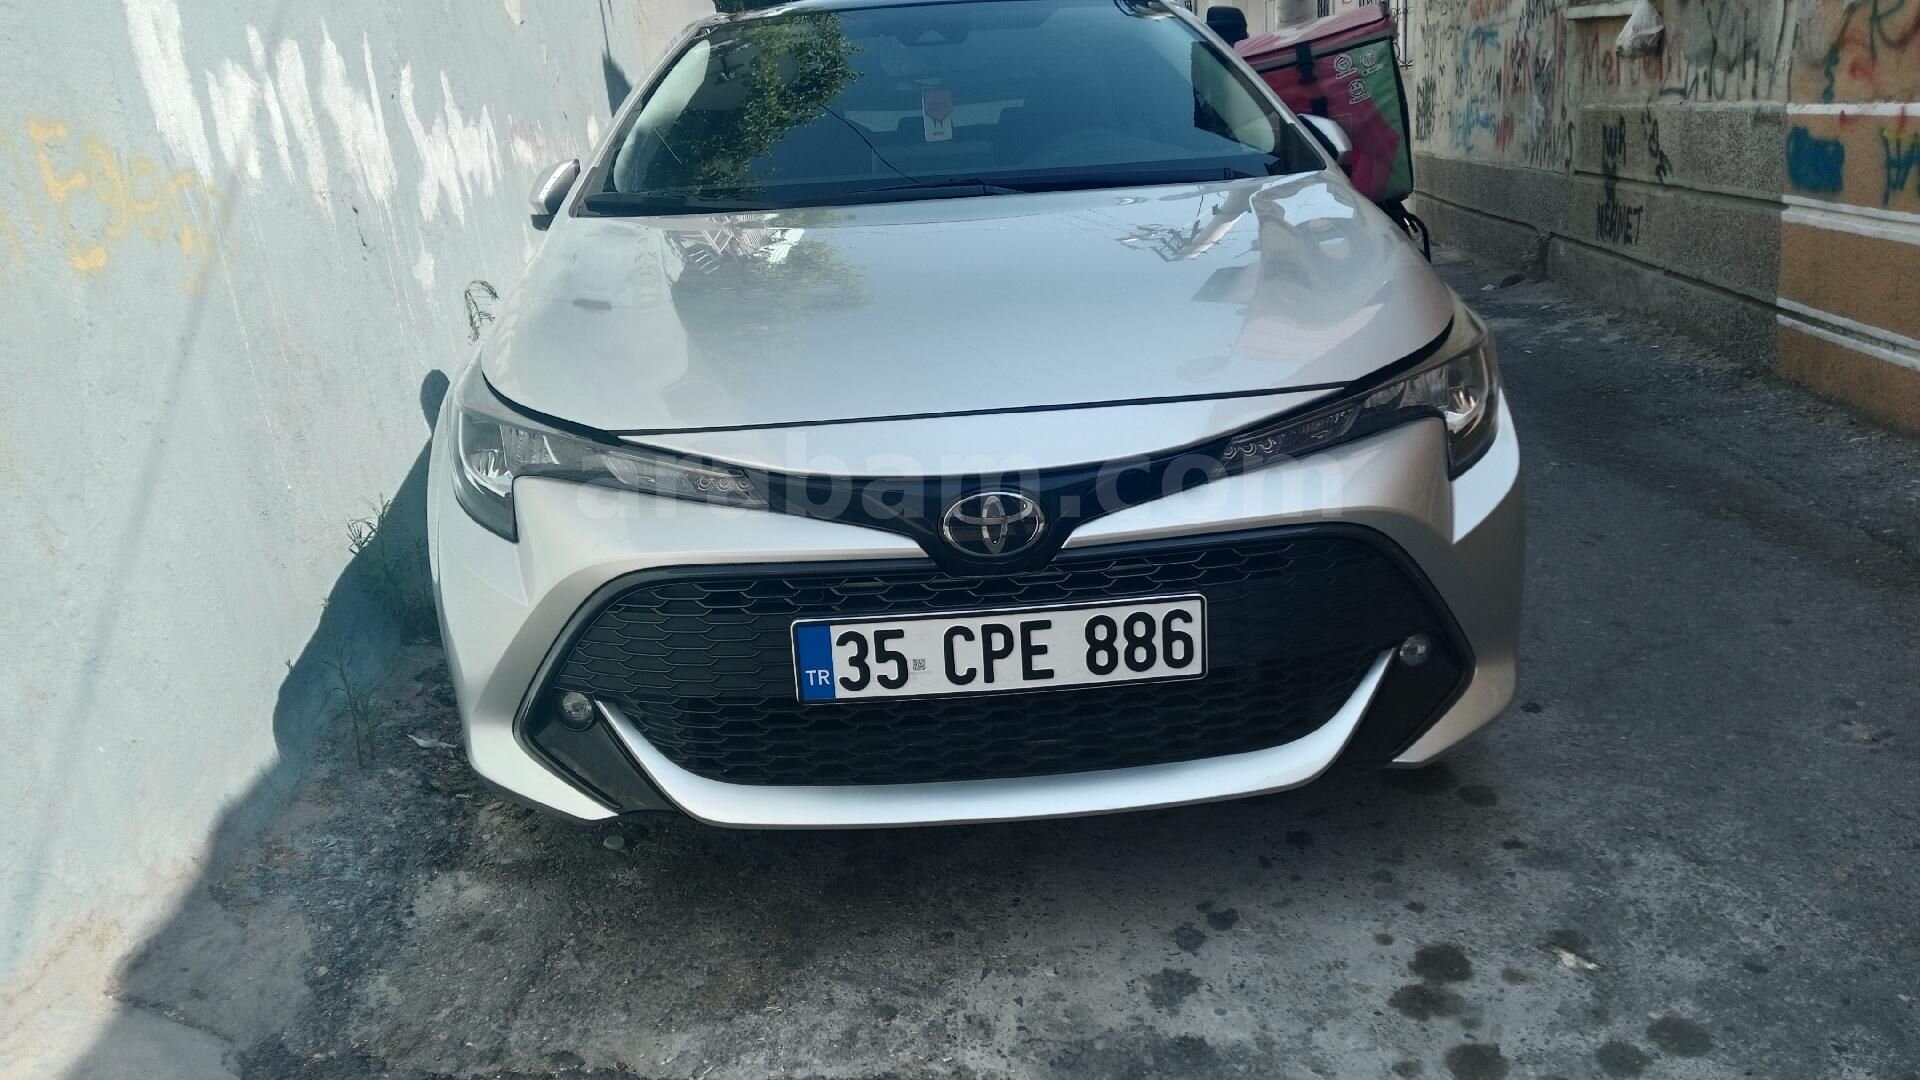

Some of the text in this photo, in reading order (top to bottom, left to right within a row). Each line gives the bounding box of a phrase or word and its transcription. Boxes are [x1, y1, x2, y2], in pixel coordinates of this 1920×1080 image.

[836, 608, 1195, 692] 35 CPE 886
[805, 669, 831, 687] TR
